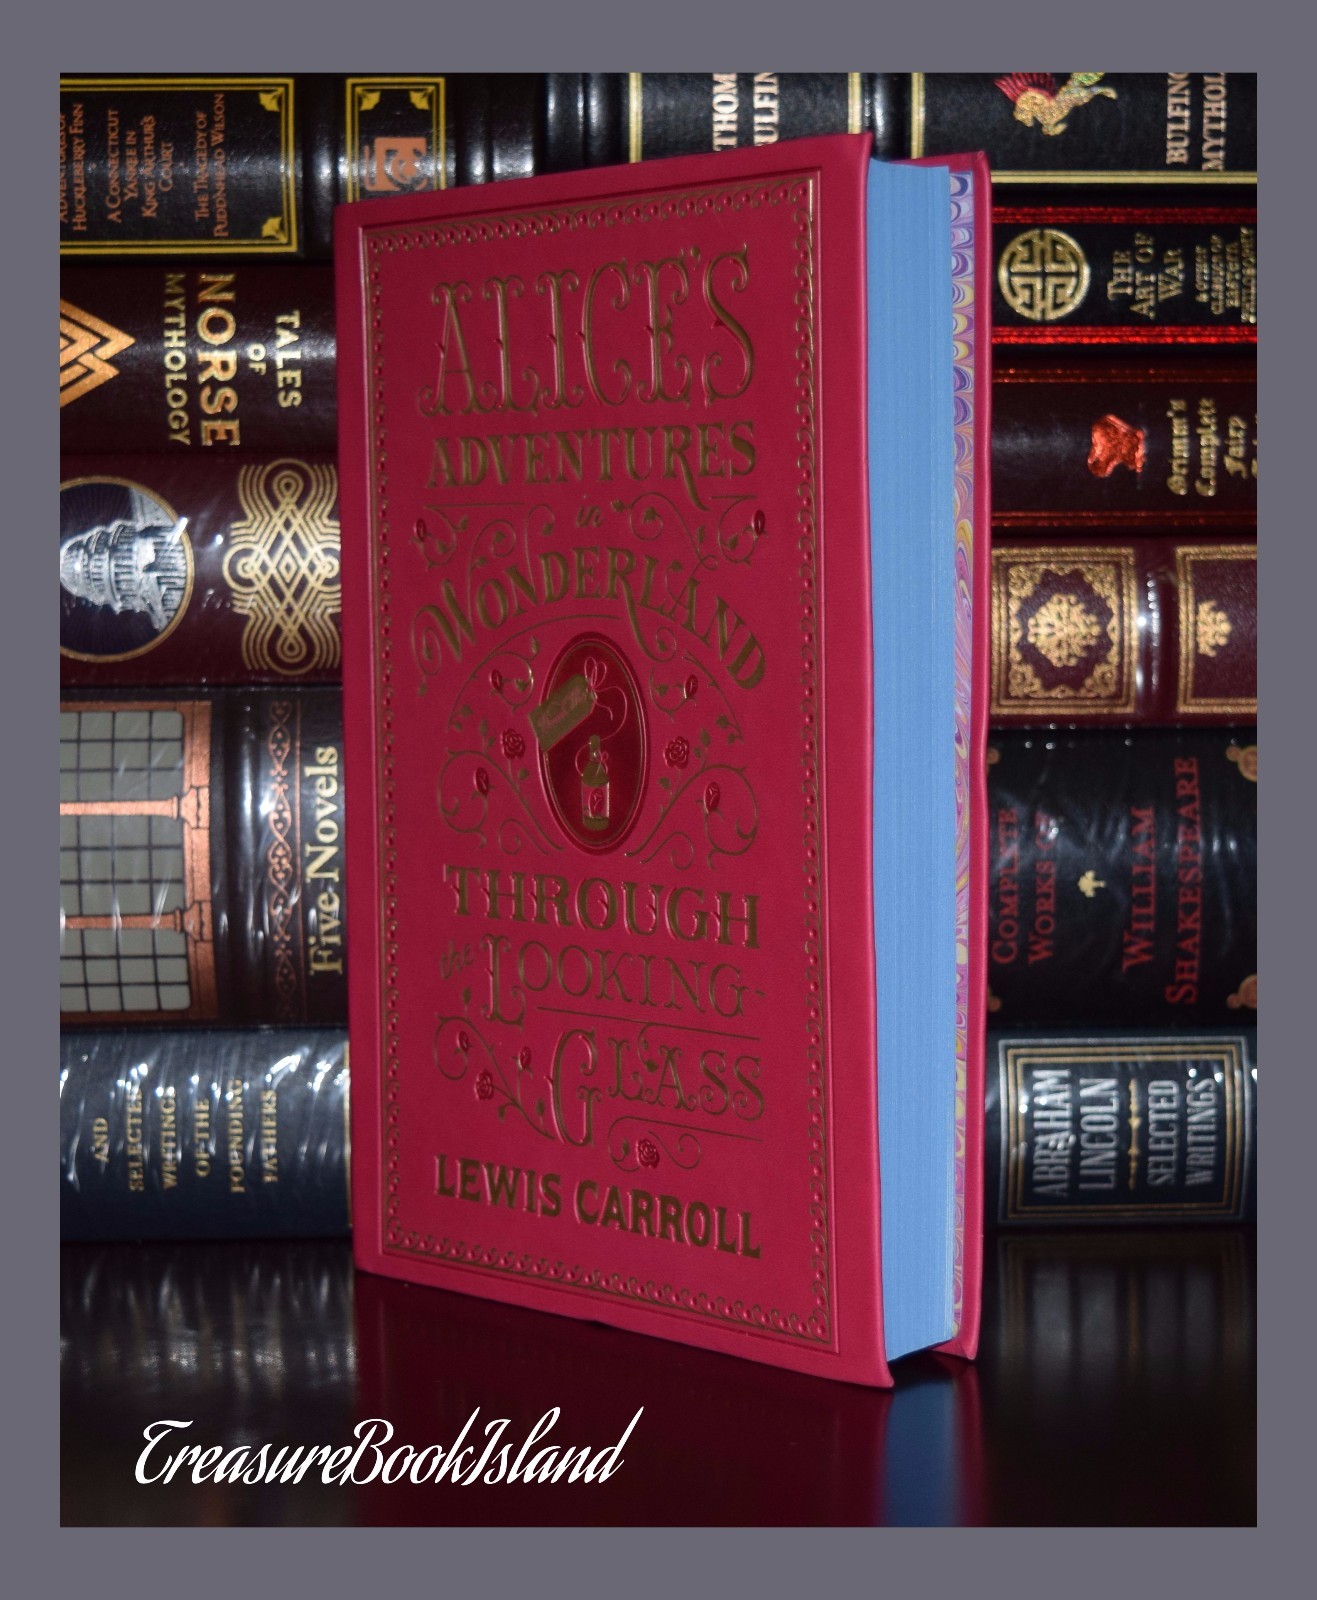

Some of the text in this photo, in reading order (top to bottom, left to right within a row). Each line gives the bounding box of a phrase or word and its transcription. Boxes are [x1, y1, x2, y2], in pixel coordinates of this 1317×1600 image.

[210, 93, 226, 146] WILSON
[753, 73, 779, 146] ULFIN
[69, 103, 87, 231] HUCKLEBERRY FINN
[105, 108, 122, 223] A CONNECTICUT
[123, 131, 138, 201] YANKEE IN
[140, 115, 158, 218] KING ARTHUR'S
[159, 141, 174, 192] COURT
[193, 111, 210, 221] THE TRAGEDY OF
[1107, 250, 1133, 301] THE
[1130, 232, 1157, 320] ART OF
[1158, 249, 1185, 302] WAR
[163, 273, 192, 446] MYTHOLOGY
[197, 273, 240, 446] NORSE
[246, 343, 267, 375] OF
[275, 310, 303, 408] TALES
[418, 242, 755, 417] ALICE'S
[426, 420, 757, 511] ADVENTURES
[1166, 398, 1190, 496] Grimm's
[1194, 398, 1221, 497] Complete
[575, 503, 605, 529] in
[411, 545, 767, 691] WONDERLAND
[303, 745, 343, 976] Five Novels
[443, 863, 762, 950] THROUGH
[992, 806, 1019, 965] COMPLETE
[1027, 860, 1056, 965] WORKS
[1122, 805, 1156, 974] WILLIAM
[1165, 756, 1202, 1005] SHAKESPEARE
[440, 938, 475, 980] the
[92, 1116, 109, 1164] AND
[194, 1098, 211, 1178] OF THE
[547, 1028, 766, 1148] GLASS
[1032, 1069, 1074, 1197] ABRAHAM
[1078, 1077, 1120, 1190] LINCOLN
[1147, 1079, 1181, 1187] SELECTED
[1185, 1078, 1218, 1187] WRITINGS
[434, 1152, 762, 1260] LEWIS CARROLL
